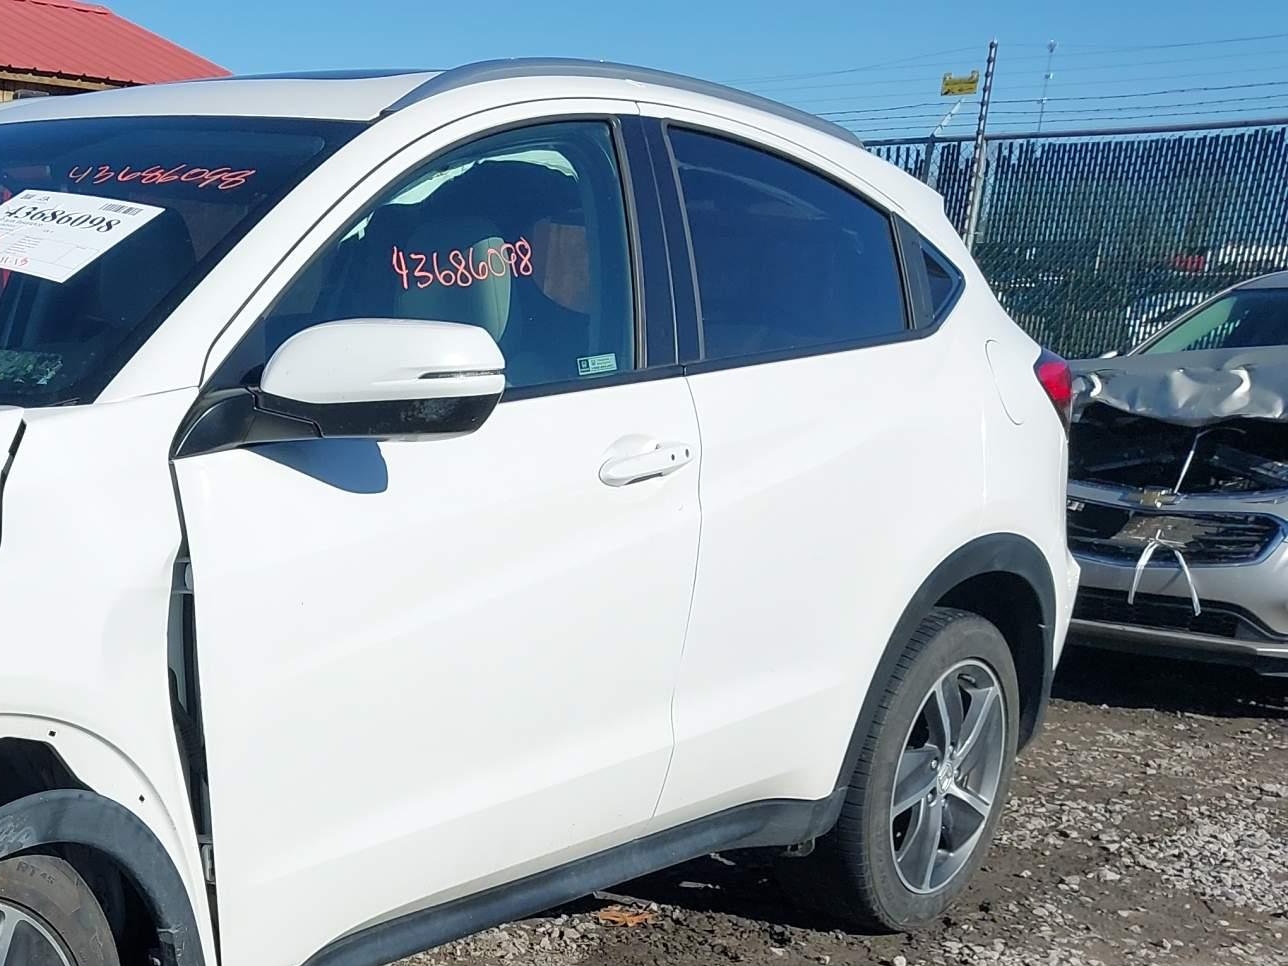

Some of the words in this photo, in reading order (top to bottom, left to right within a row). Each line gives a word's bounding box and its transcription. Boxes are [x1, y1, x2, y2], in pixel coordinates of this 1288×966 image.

[68, 163, 257, 190] 43686098
[5, 204, 121, 233] 43686098
[392, 236, 533, 289] 43686098
